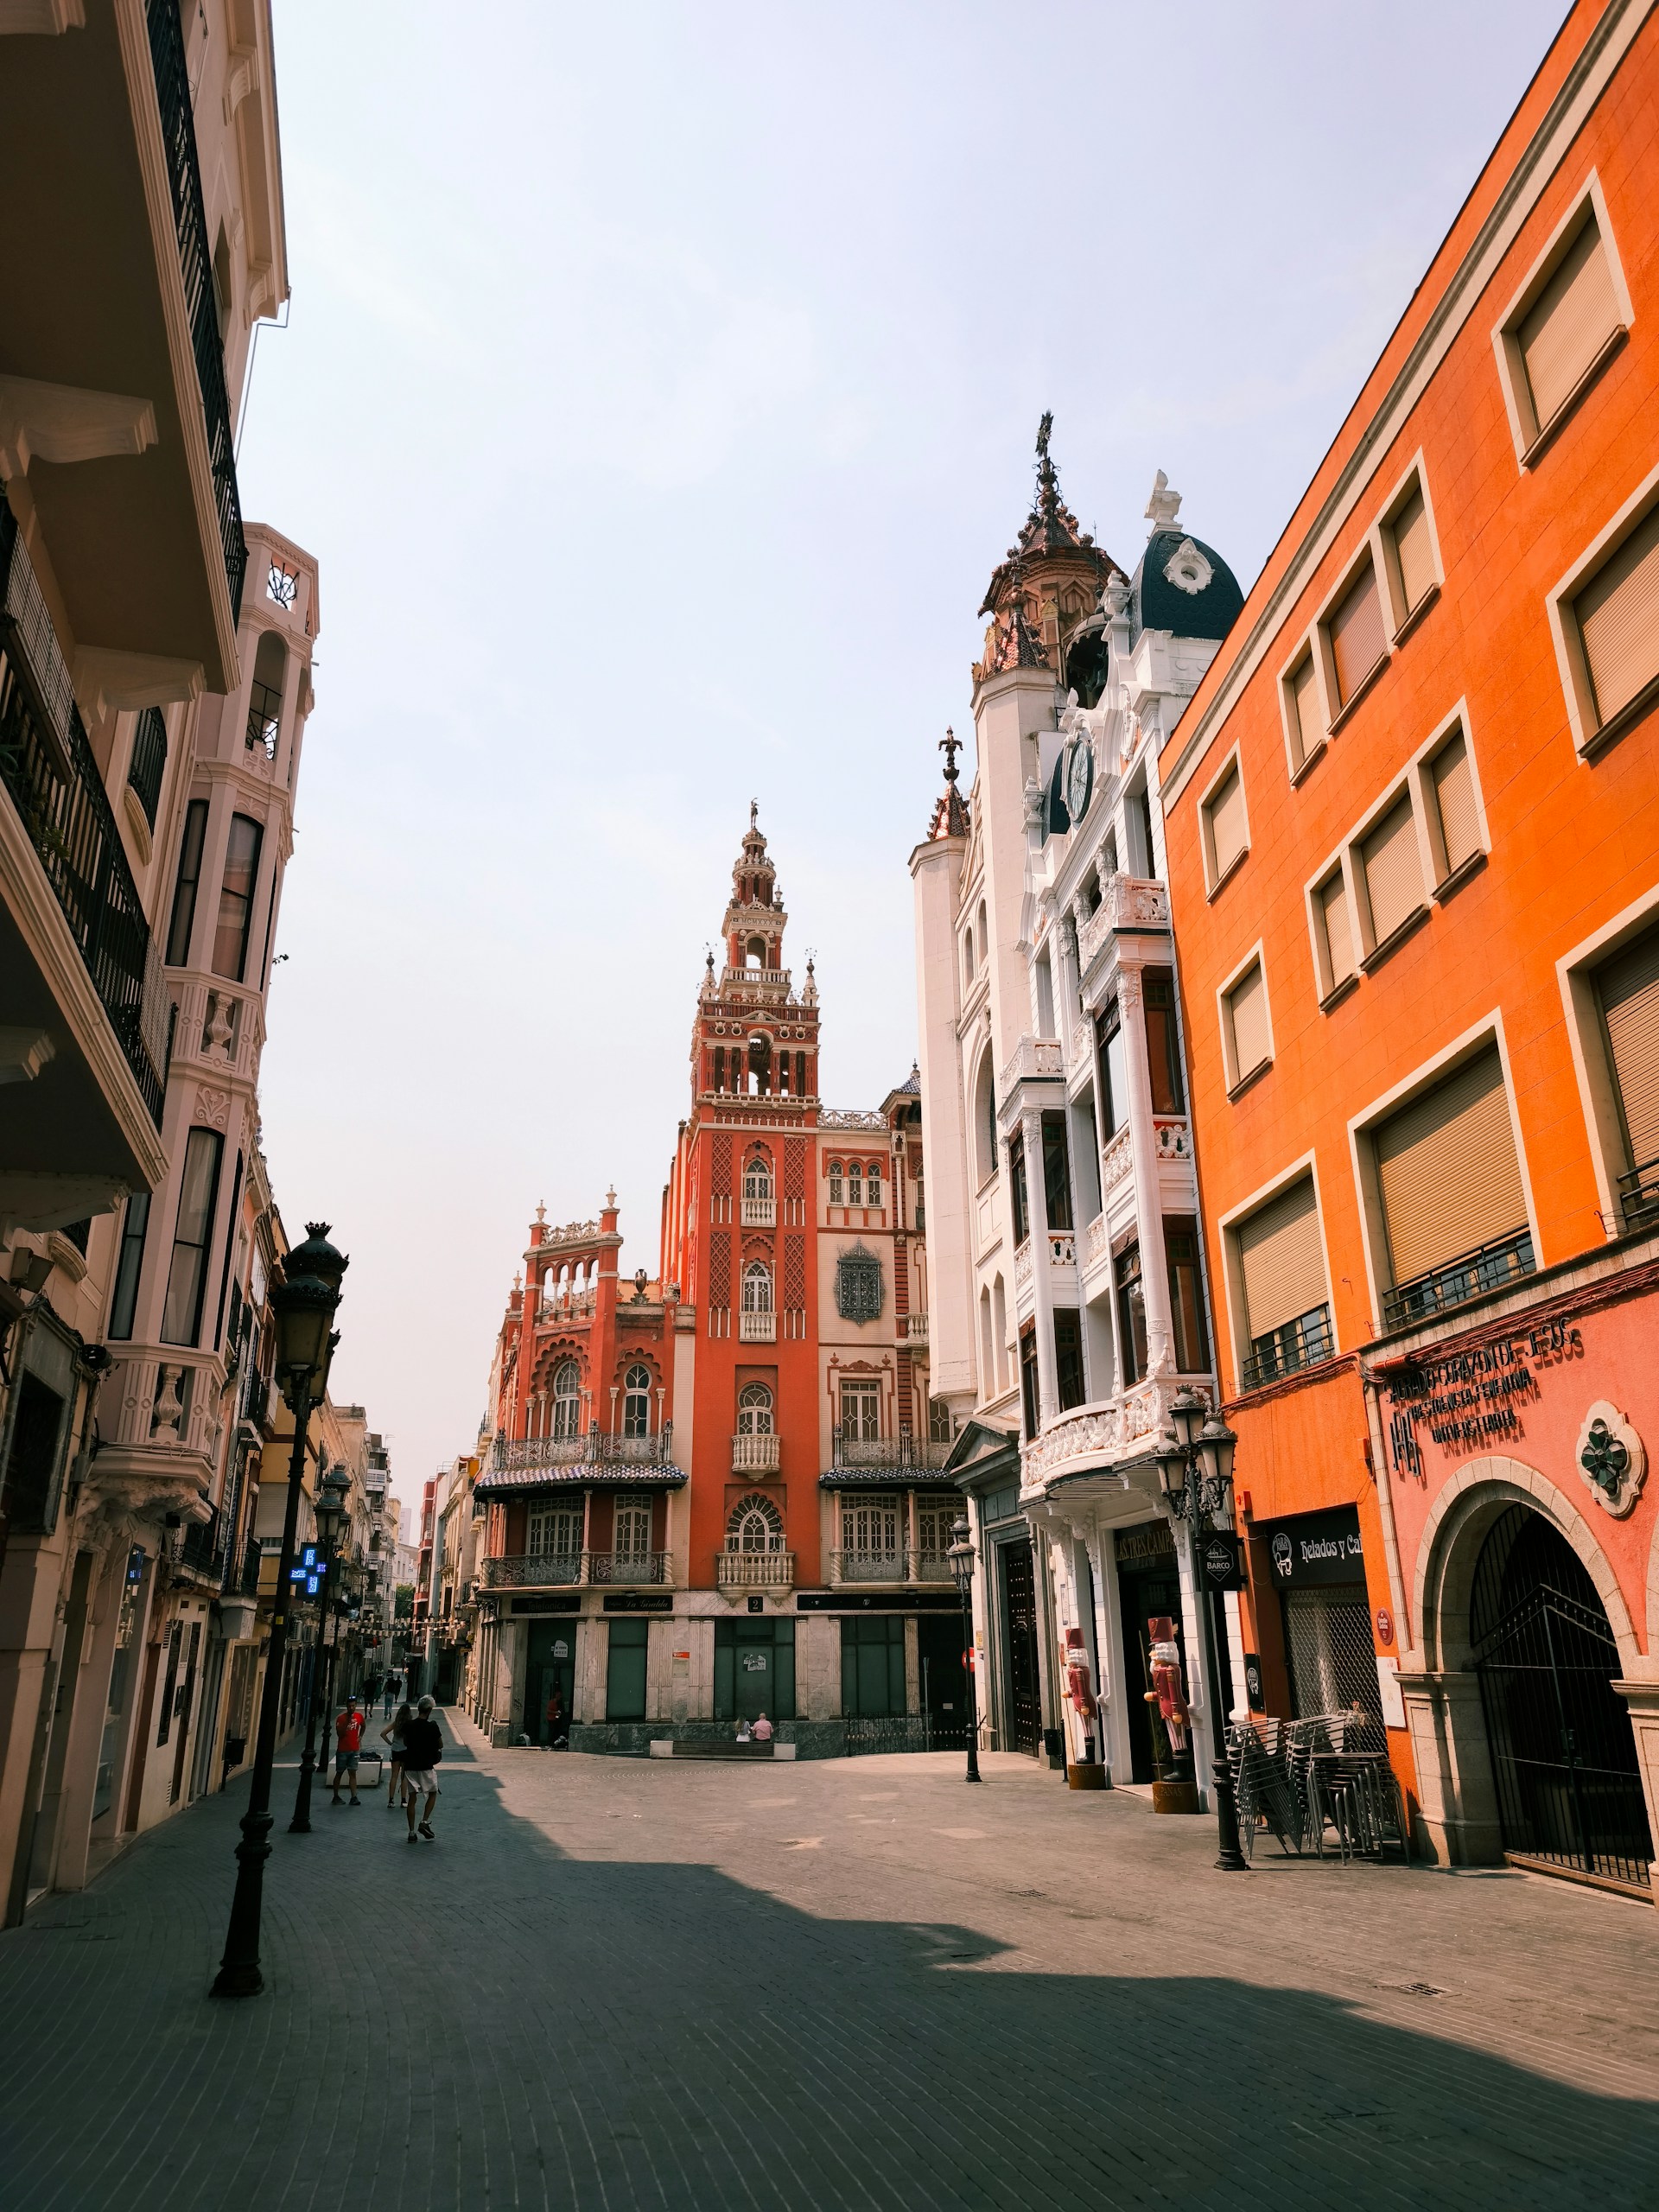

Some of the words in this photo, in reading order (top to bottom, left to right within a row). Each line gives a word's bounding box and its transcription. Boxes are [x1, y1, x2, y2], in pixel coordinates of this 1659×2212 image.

[1383, 1367, 1435, 1404] SAGRADO
[1437, 1345, 1498, 1387] CORAZON
[1497, 1338, 1523, 1367] DE
[1523, 1317, 1575, 1357] JESUS
[1409, 1387, 1473, 1420] RESIDENCIA
[1474, 1368, 1533, 1401] FEMENINA
[1432, 1408, 1517, 1444] UNIVERSITARIA
[1115, 1538, 1129, 1560] LAS
[1128, 1535, 1148, 1559] TRES
[1338, 1540, 1345, 1560] y
[1206, 1561, 1230, 1570] BARCO
[640, 1599, 669, 1608] Giralda
[753, 1599, 759, 1610] 2
